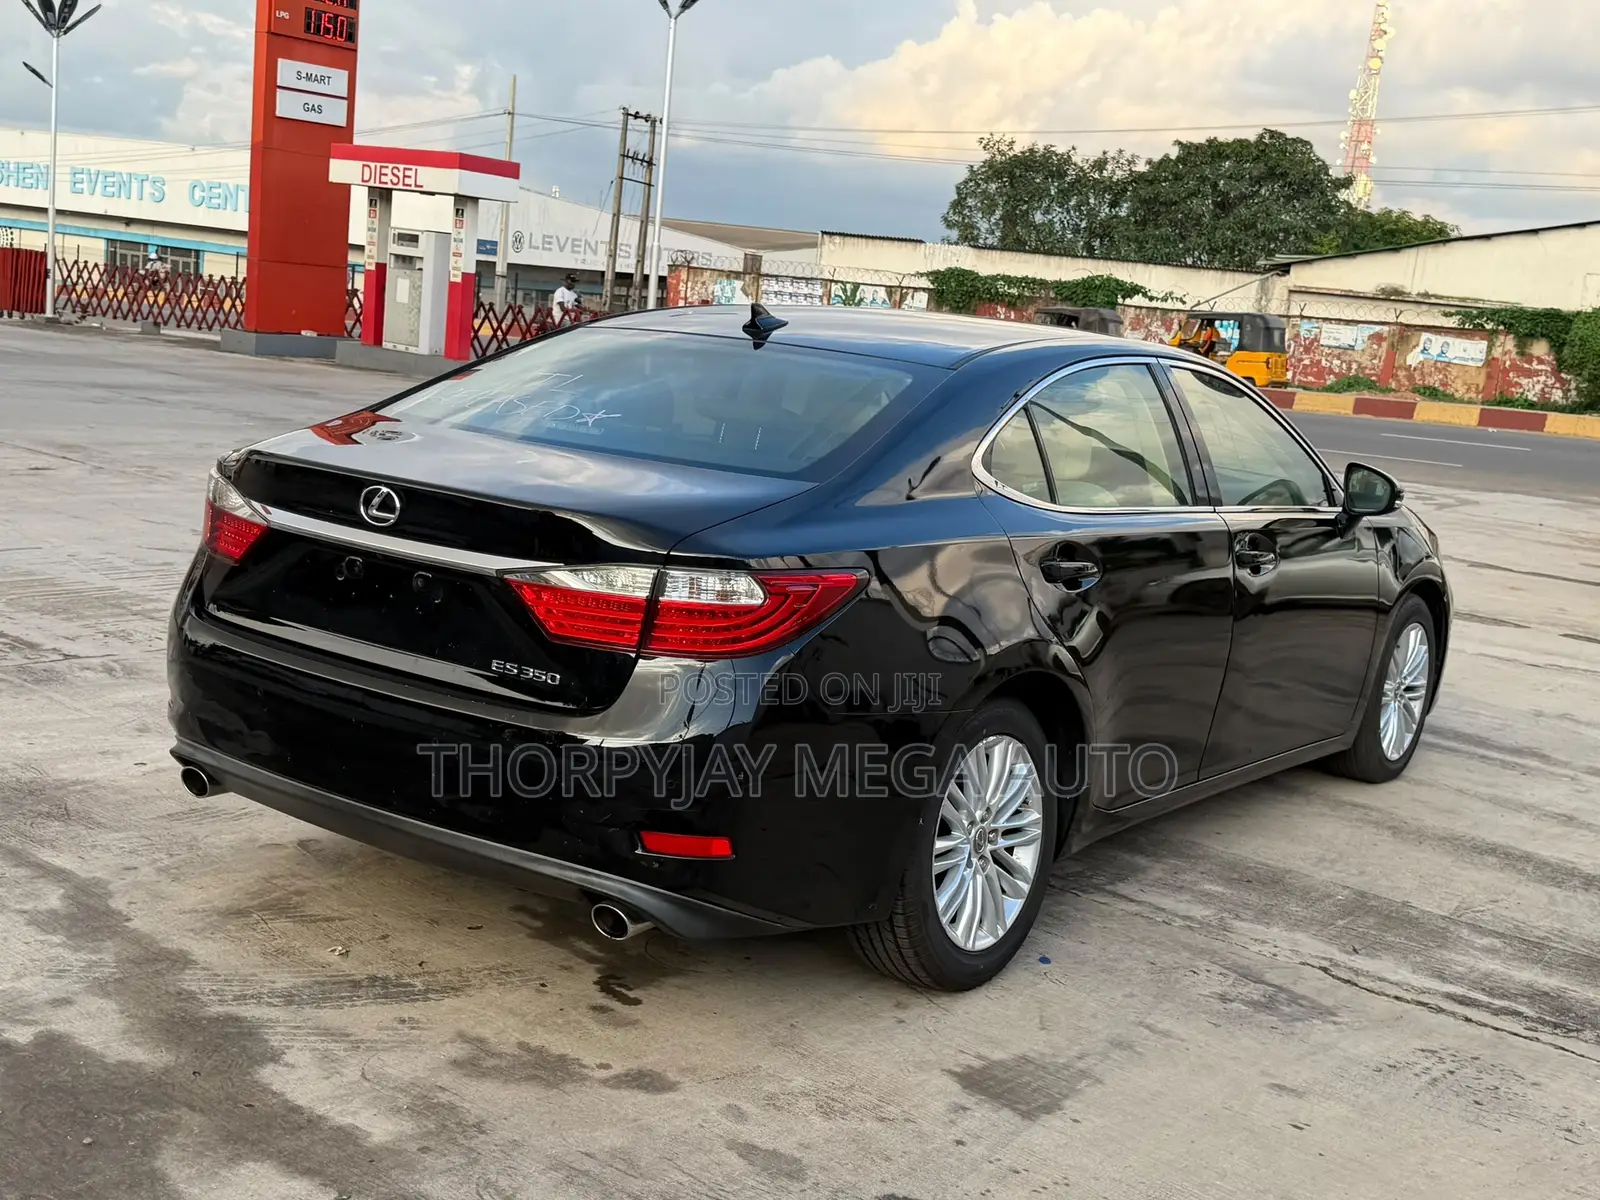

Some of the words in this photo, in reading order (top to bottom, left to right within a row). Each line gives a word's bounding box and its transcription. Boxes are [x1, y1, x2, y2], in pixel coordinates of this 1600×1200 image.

[296, 70, 332, 86] S-MART
[303, 102, 323, 114] GAS
[69, 166, 166, 203] EVENTS
[361, 164, 424, 188] DIESEL
[528, 232, 632, 260] LEVENTS
[491, 659, 518, 675] ES
[520, 666, 560, 685] 350
